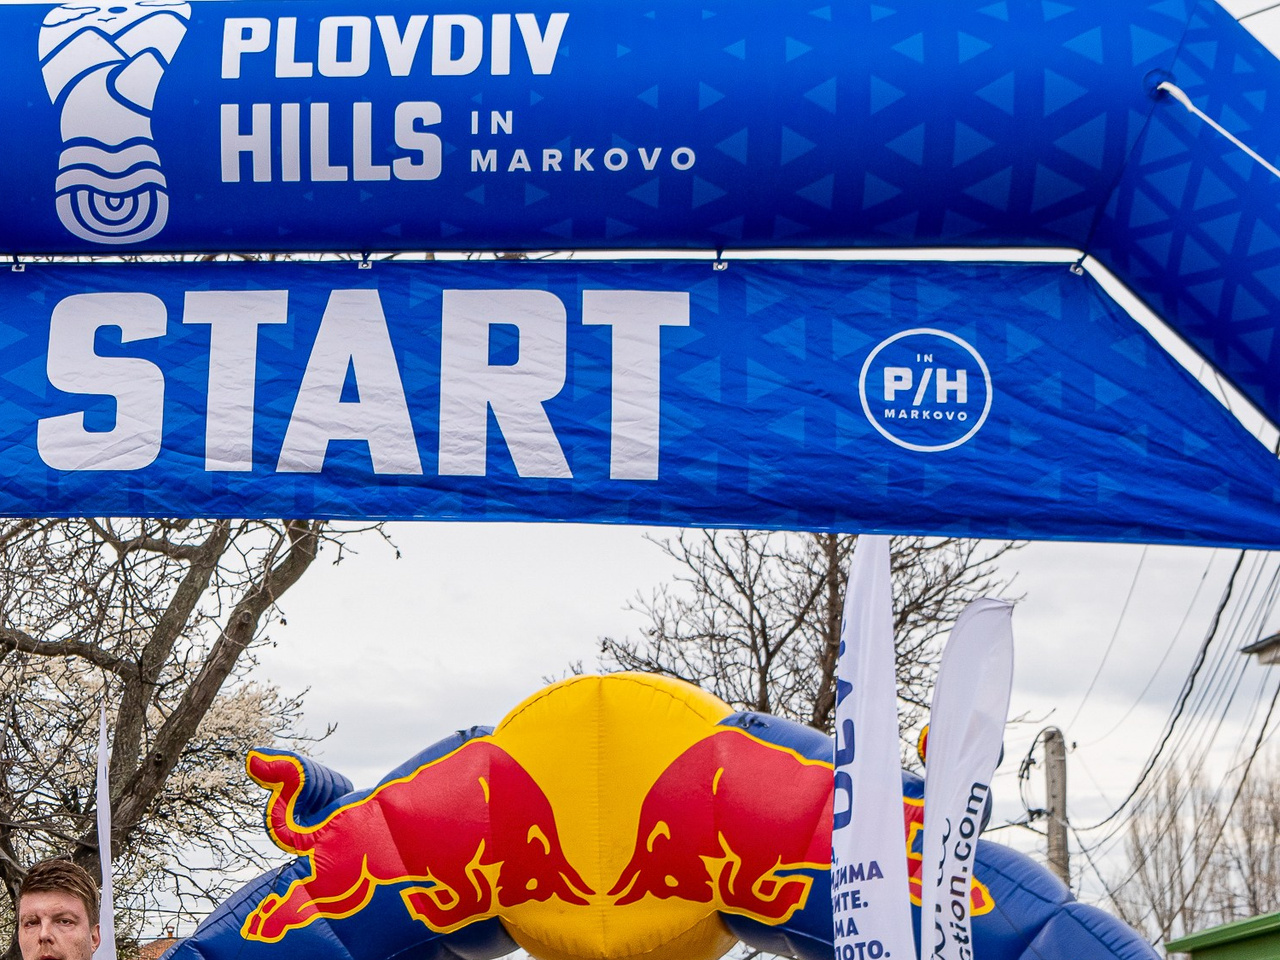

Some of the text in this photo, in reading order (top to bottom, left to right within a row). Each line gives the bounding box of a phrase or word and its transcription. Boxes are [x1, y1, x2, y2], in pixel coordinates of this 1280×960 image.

[221, 12, 570, 79] PLOVDIV
[470, 110, 514, 136] IN
[220, 101, 443, 183] HILLS
[470, 146, 697, 173] MARKOVO
[916, 353, 933, 363] IN
[36, 288, 691, 482] START
[883, 366, 968, 406] P/H
[884, 409, 968, 422] MARKOVO
